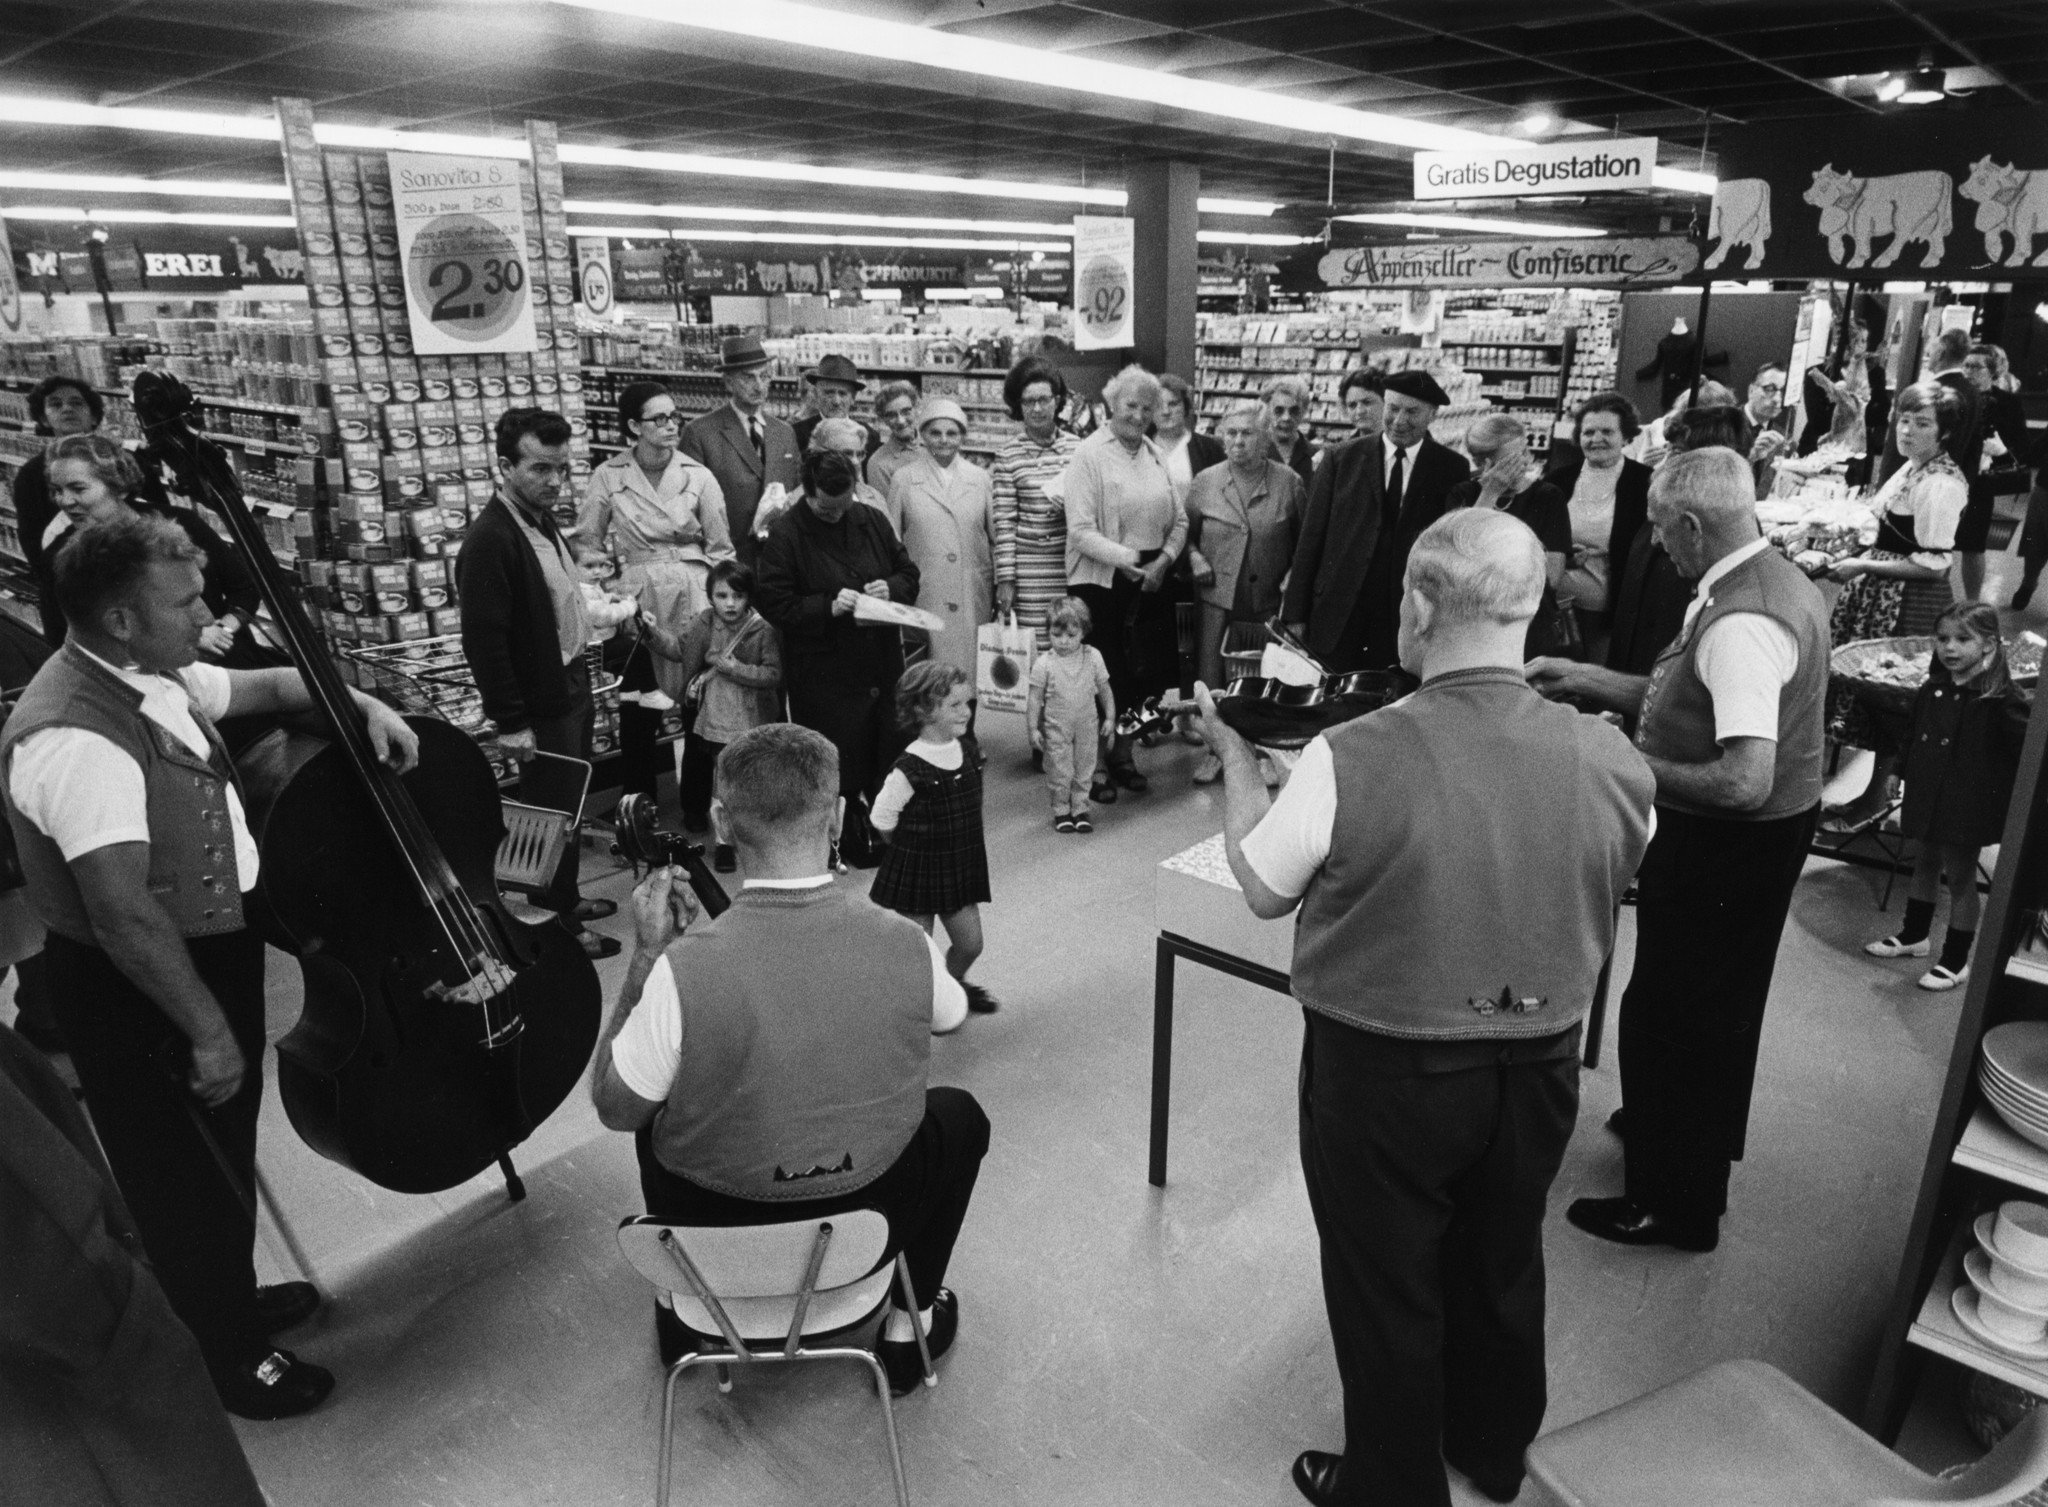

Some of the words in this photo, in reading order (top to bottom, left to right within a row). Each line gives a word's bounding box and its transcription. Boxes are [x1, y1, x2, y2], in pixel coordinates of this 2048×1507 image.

[400, 167, 481, 188] Sanovita
[488, 165, 502, 183] S
[1427, 161, 1489, 186] Gratis
[1494, 153, 1641, 186] Degustation
[1340, 245, 1478, 285] Appenzeller
[1506, 245, 1642, 283] Confiserie
[428, 258, 524, 322] 2.30
